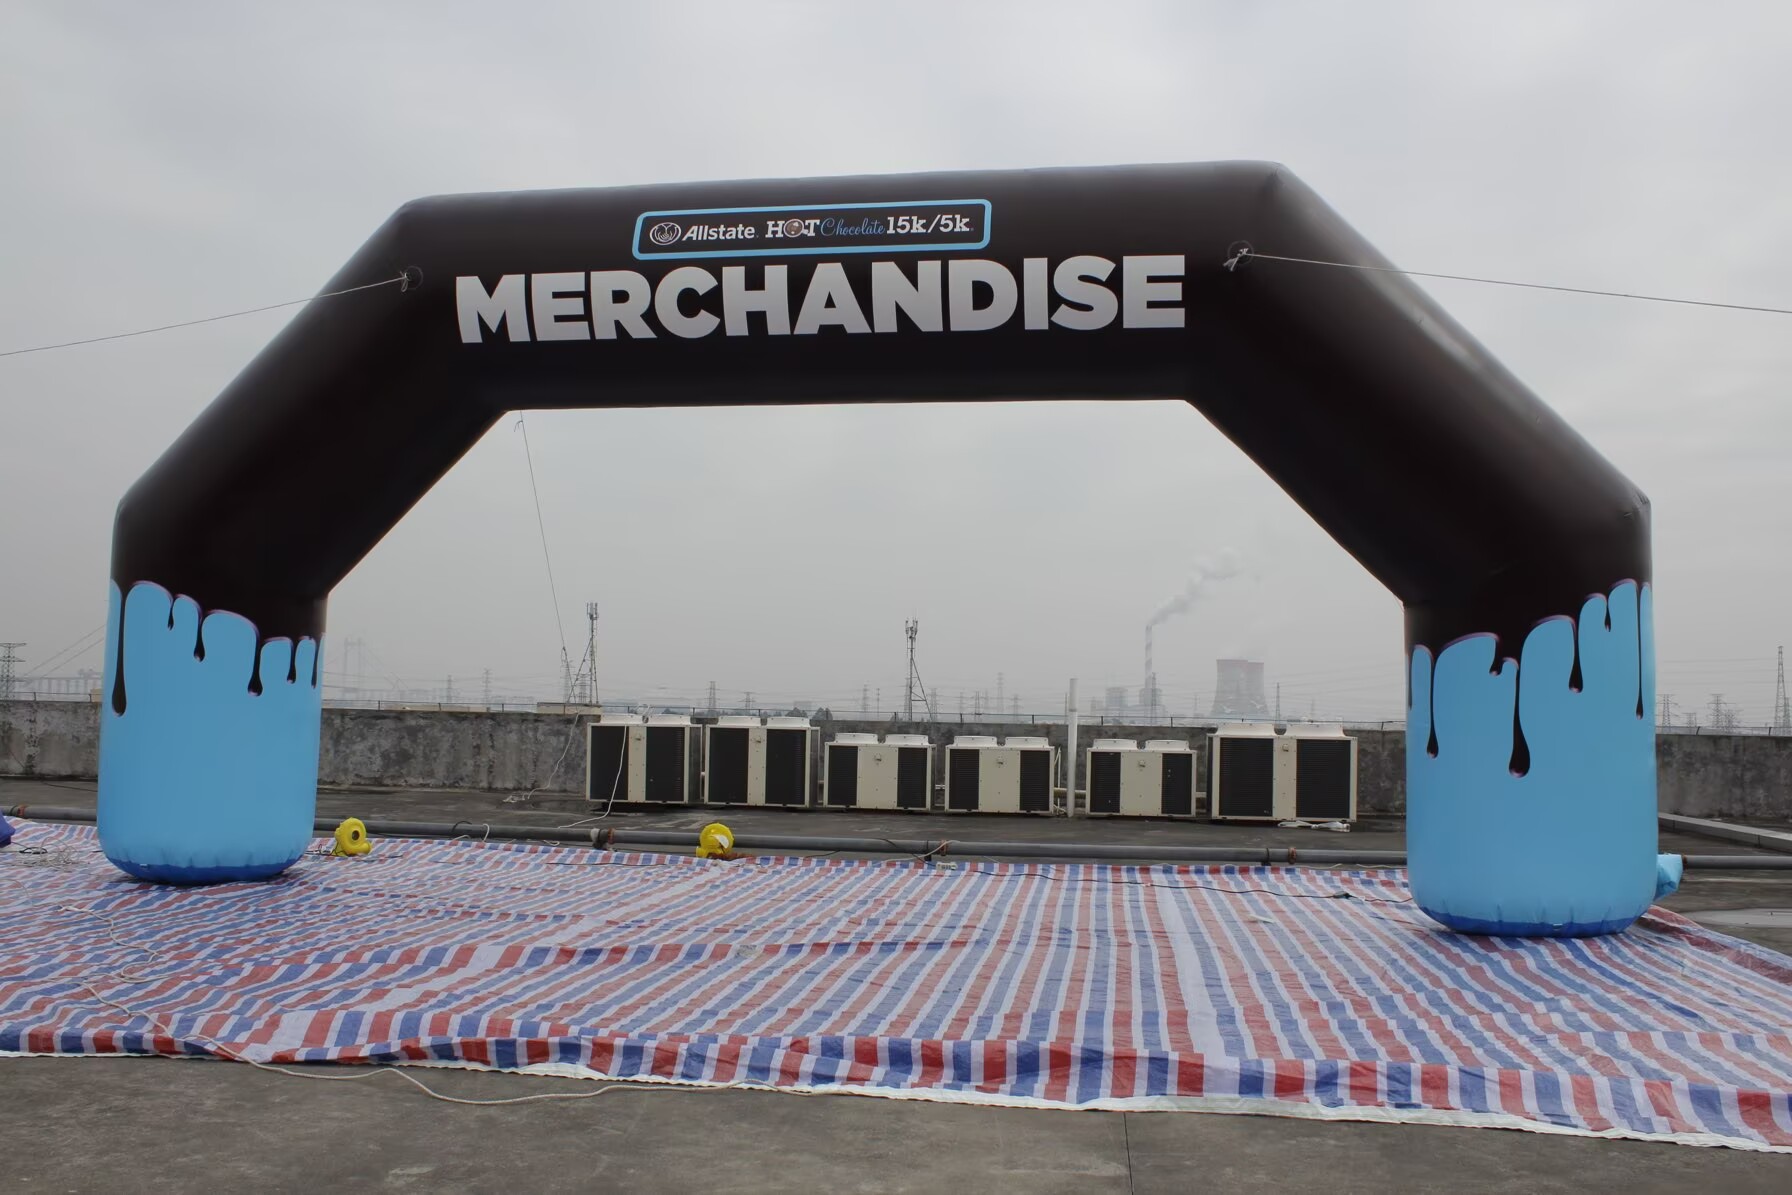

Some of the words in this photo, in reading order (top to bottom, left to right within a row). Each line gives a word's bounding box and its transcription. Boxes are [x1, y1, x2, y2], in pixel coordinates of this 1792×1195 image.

[682, 224, 755, 241] Allstate
[820, 216, 885, 237] Chocolate
[886, 214, 970, 235] 15k/5k
[455, 254, 1186, 344] MERCHANDISE
